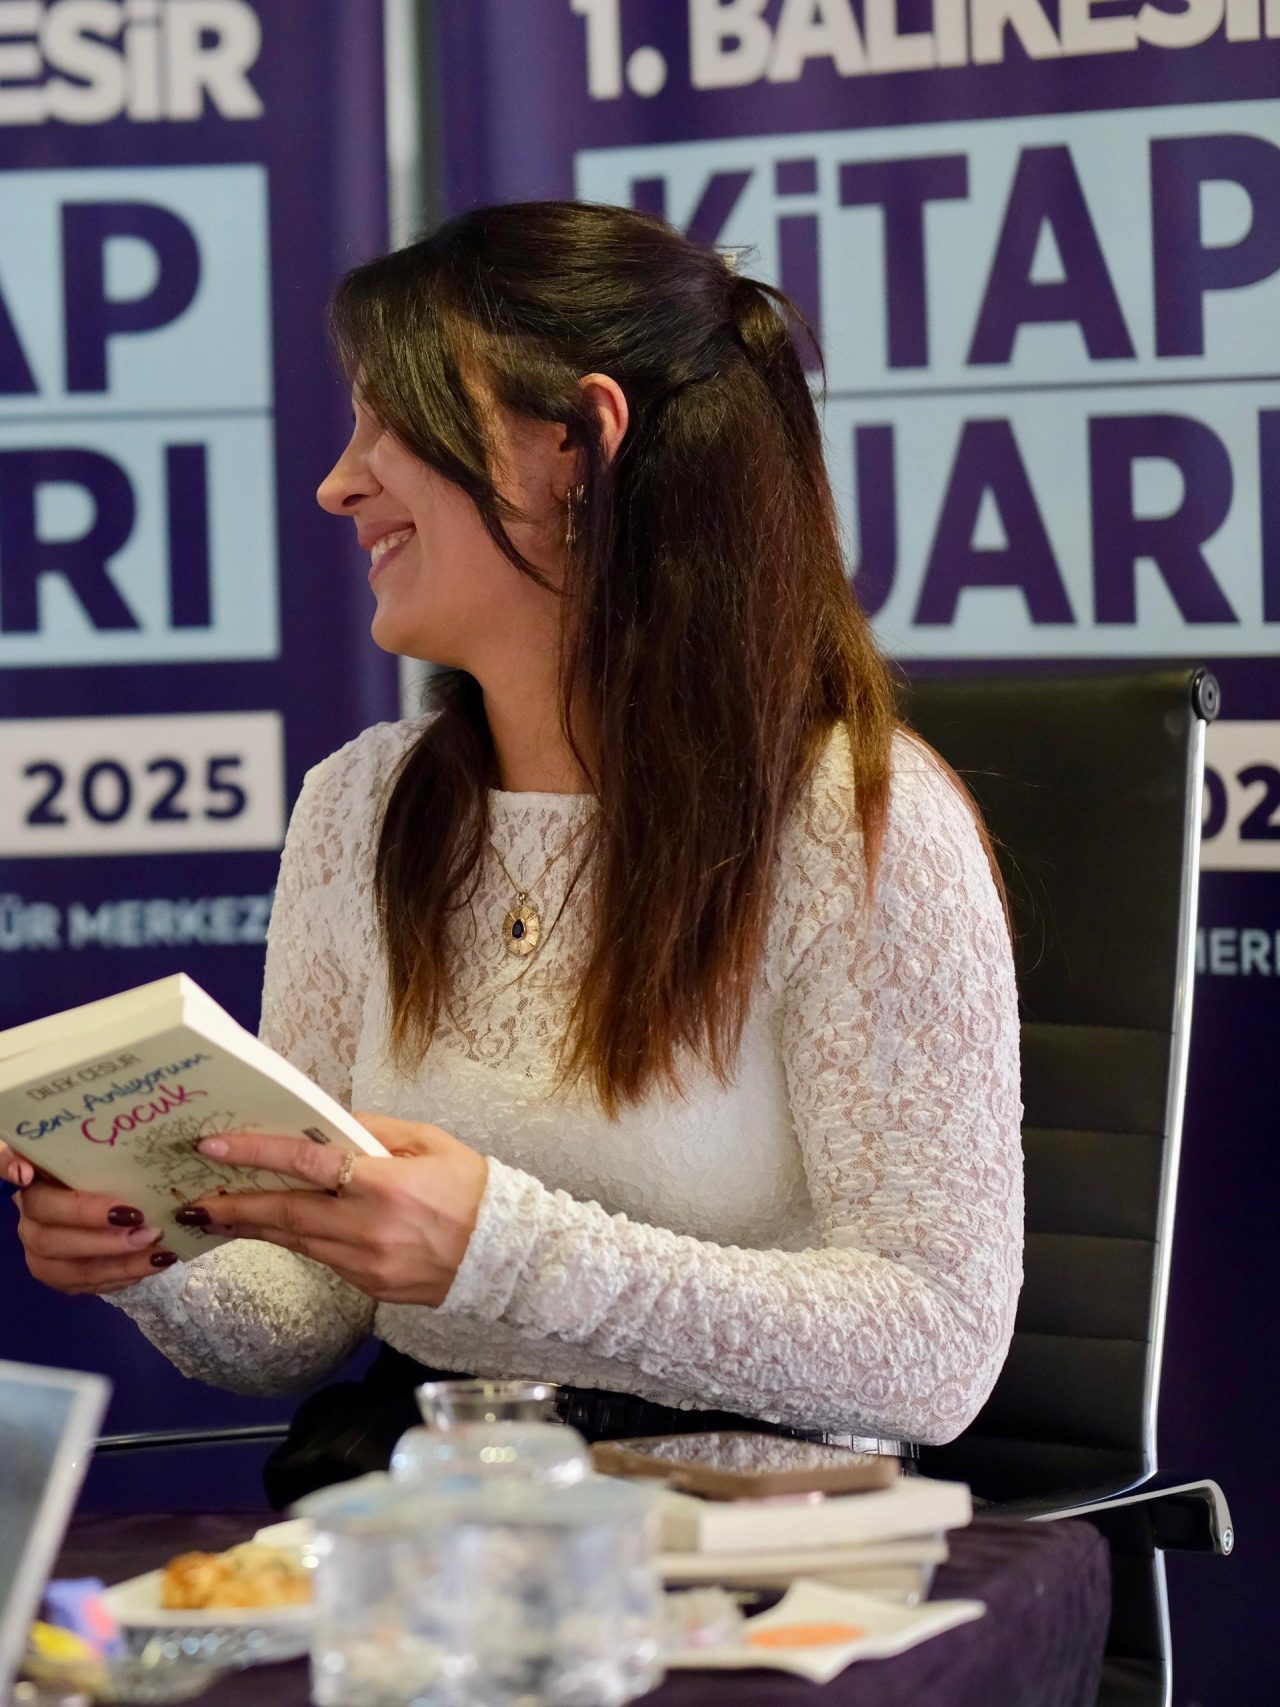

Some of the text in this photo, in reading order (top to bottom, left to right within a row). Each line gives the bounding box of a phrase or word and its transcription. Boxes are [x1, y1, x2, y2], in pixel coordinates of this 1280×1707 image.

[569, 0, 668, 100] 1.
[22, 755, 249, 828] 2025
[66, 893, 275, 949] MERKEZ
[80, 1083, 209, 1147] Çocuk
